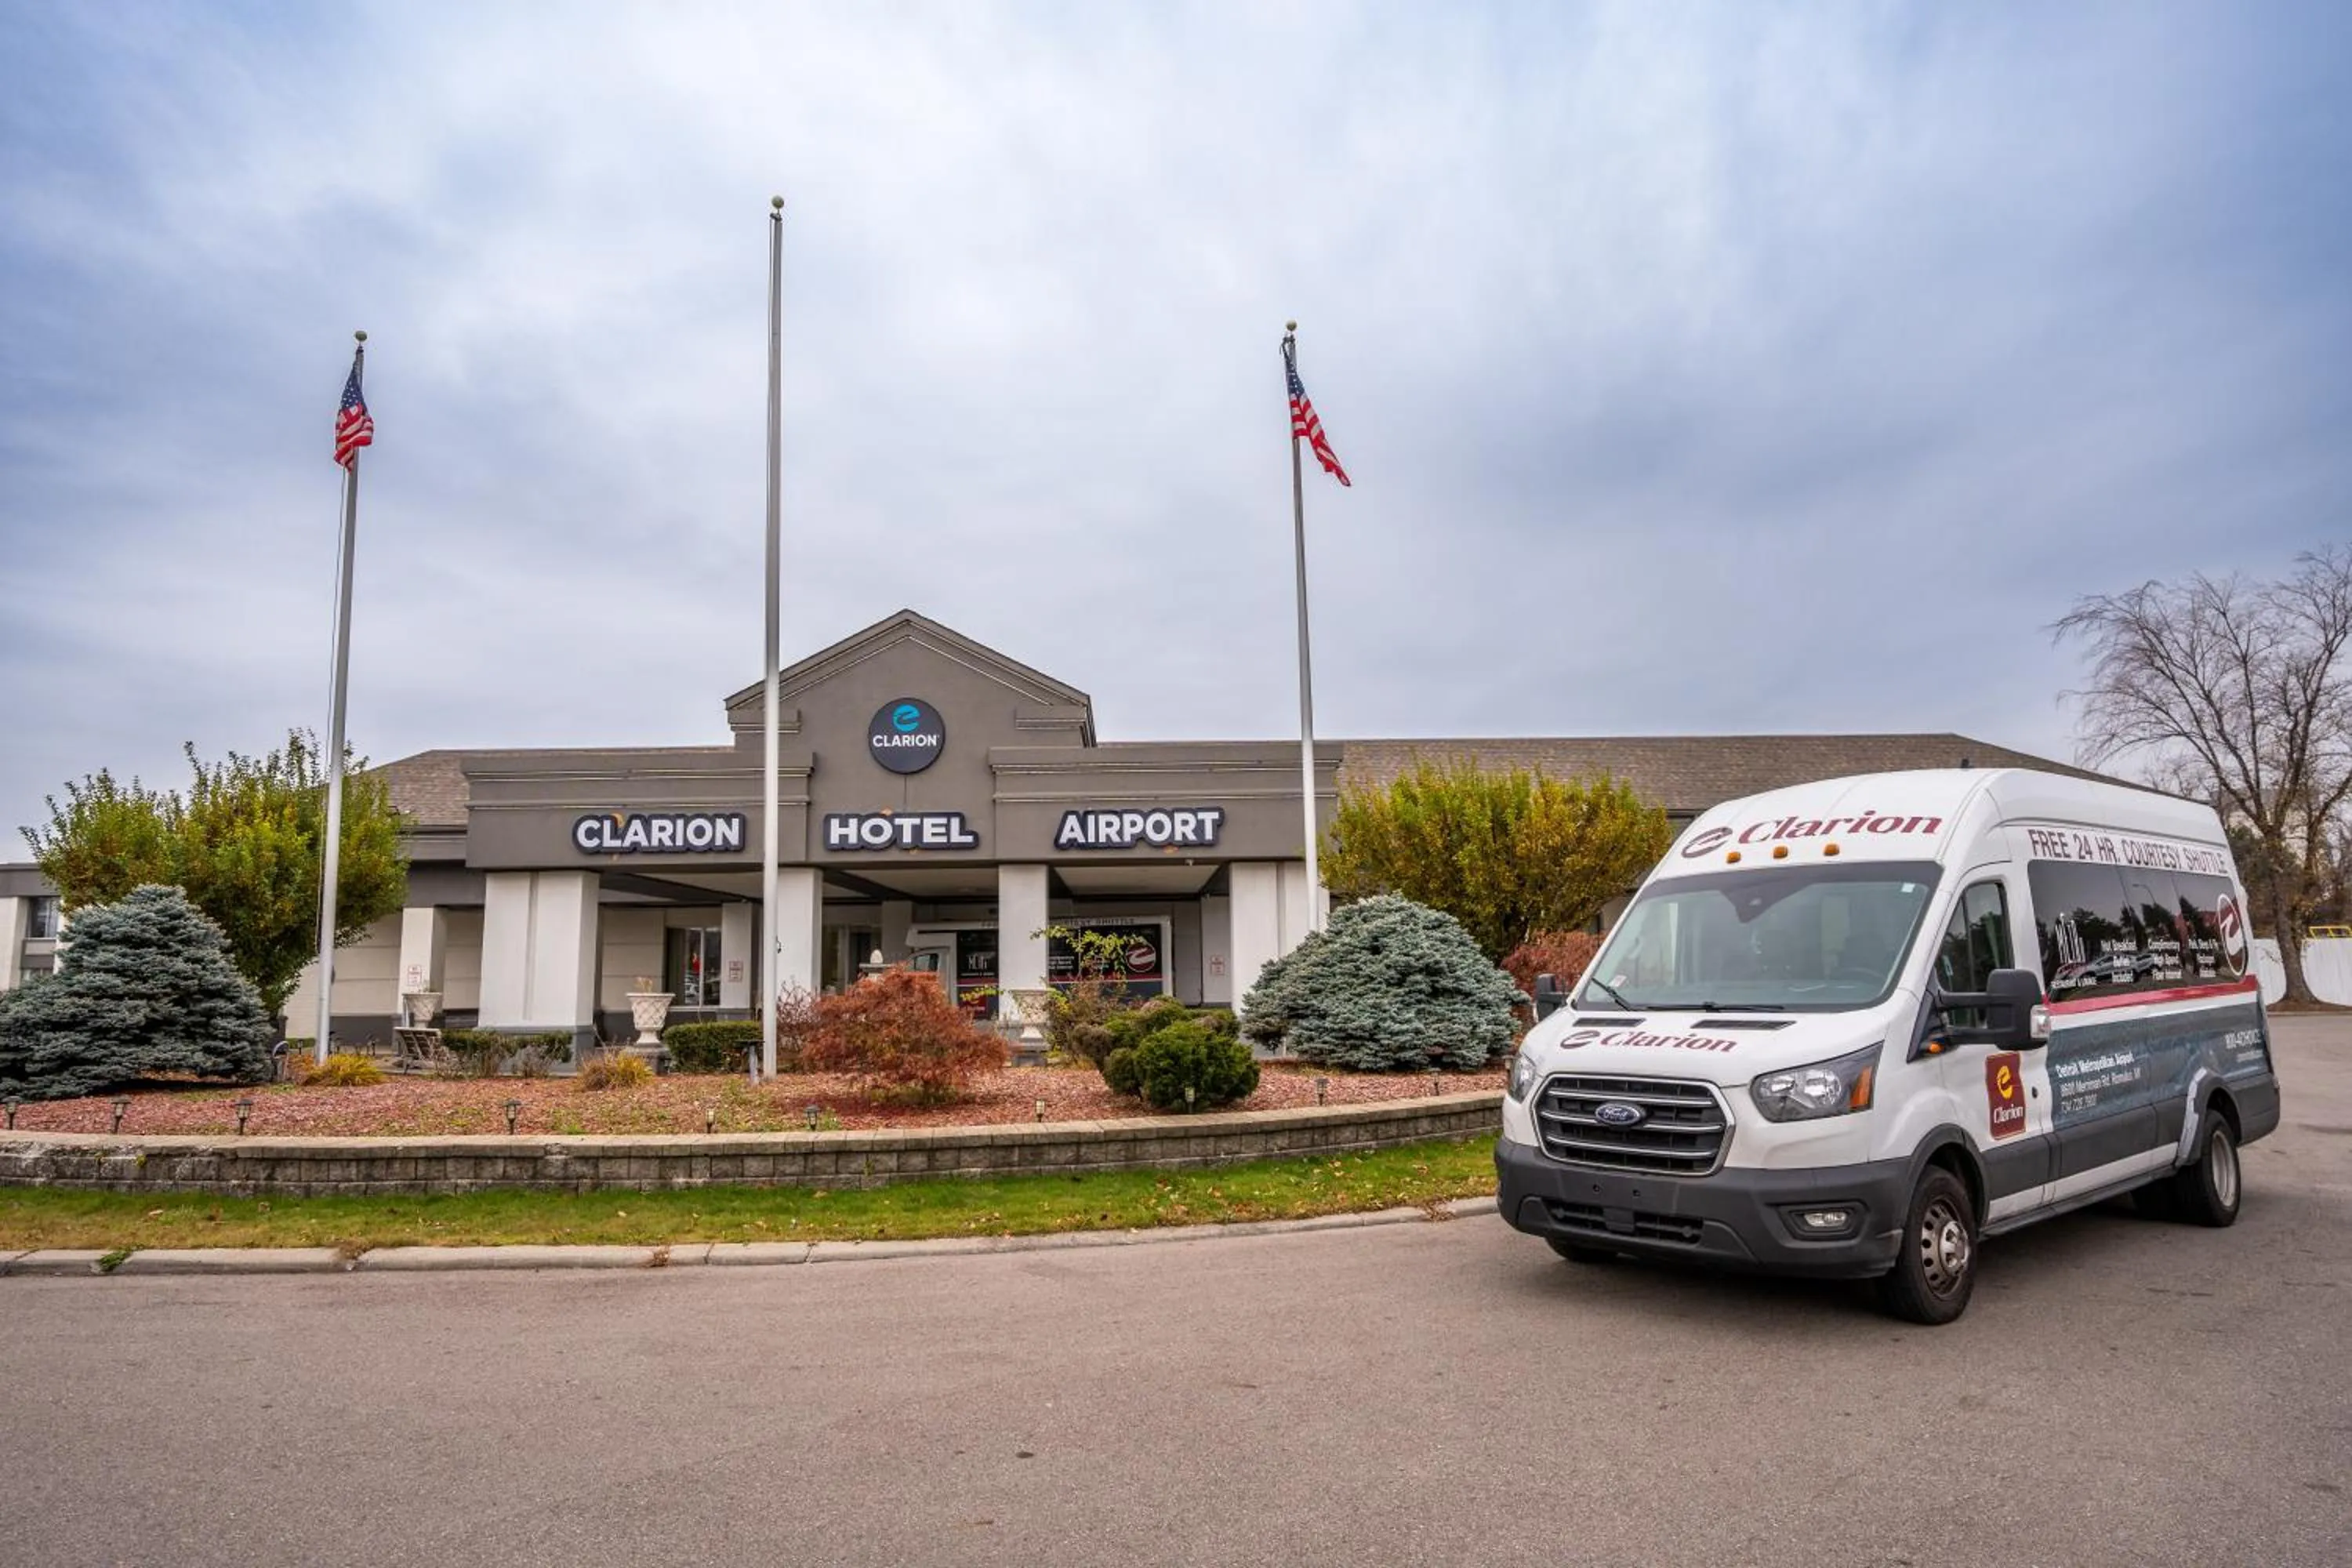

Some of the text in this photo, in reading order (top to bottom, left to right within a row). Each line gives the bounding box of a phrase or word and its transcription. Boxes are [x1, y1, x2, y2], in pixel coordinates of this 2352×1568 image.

[873, 735, 938, 747] CLARION
[576, 811, 1220, 848] CLARION HOTEL AIRPORT
[1737, 810, 1943, 844] Clarion
[2027, 829, 2072, 858] FREE
[2073, 833, 2093, 861] 24
[2122, 838, 2182, 870] COURTESY
[2183, 846, 2228, 874] SHUTTLE
[1599, 1030, 1738, 1053] Clarion
[1994, 1103, 2024, 1123] Clarion
